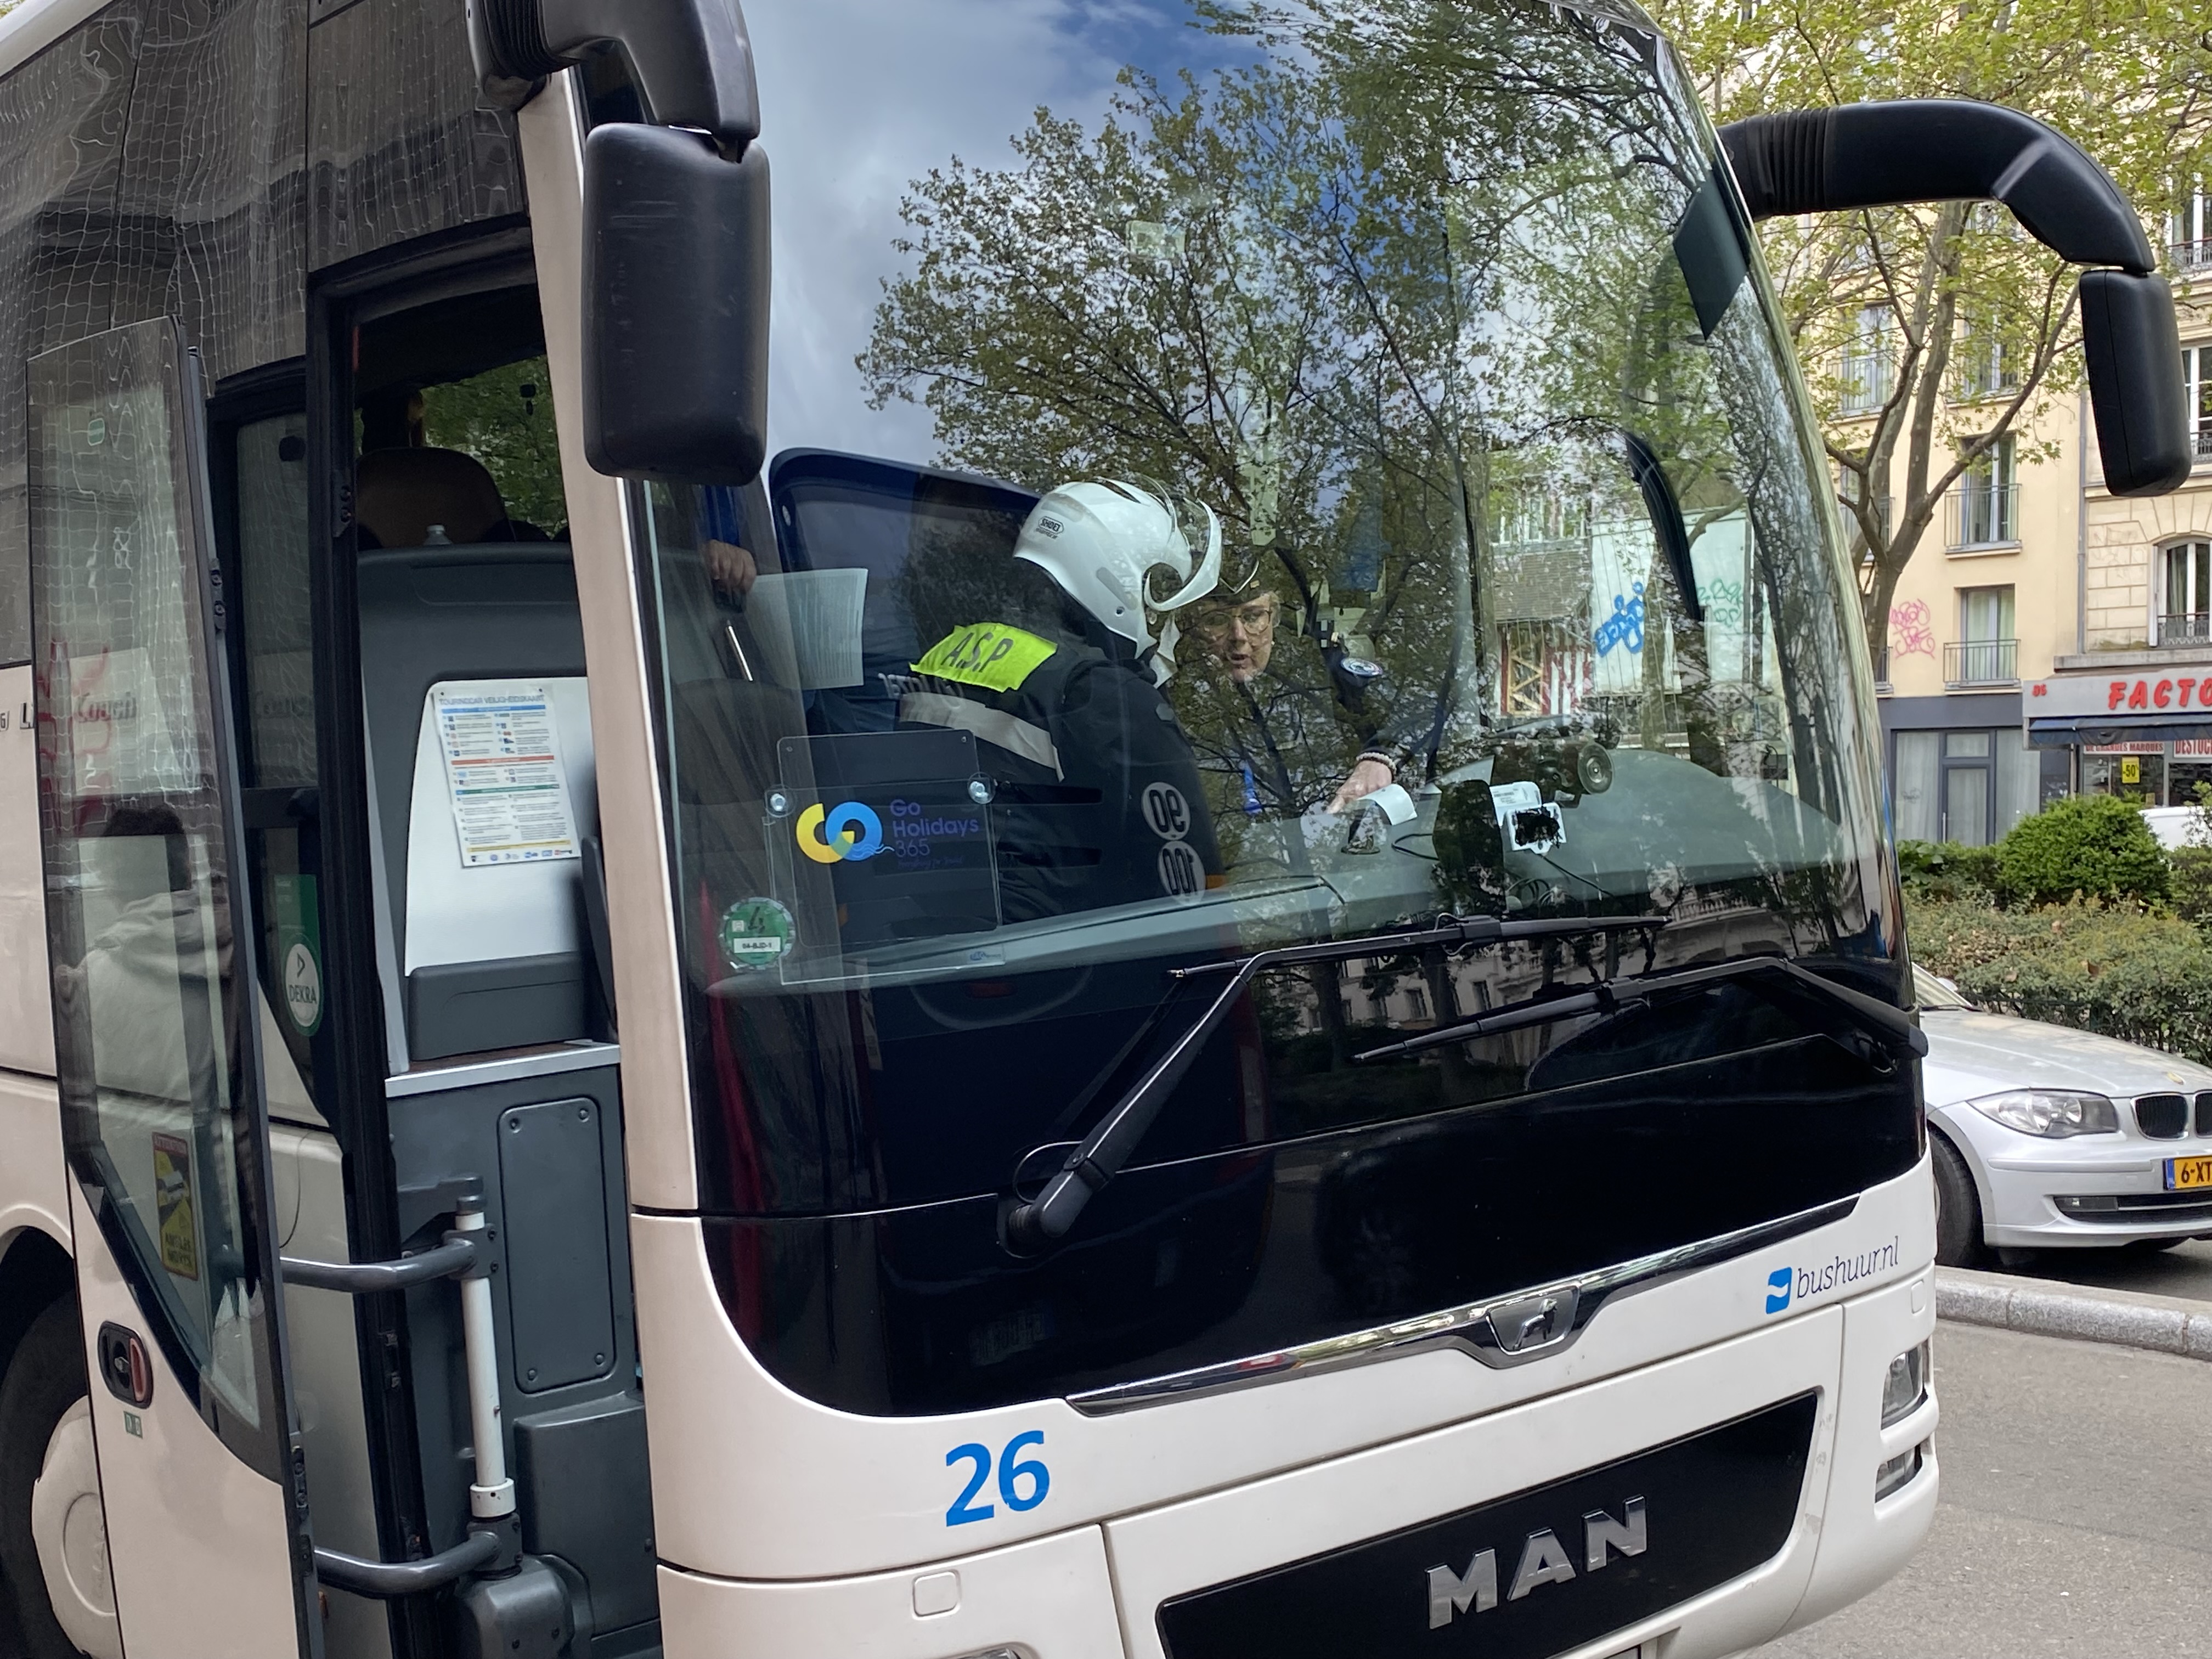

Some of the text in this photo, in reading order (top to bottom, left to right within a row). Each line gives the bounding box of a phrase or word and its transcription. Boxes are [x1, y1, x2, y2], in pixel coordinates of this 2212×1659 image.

[2130, 743, 2164, 752] MARQUES
[890, 799, 921, 816] Go
[893, 817, 979, 838] Holidays
[895, 838, 930, 857] 365
[289, 984, 317, 1005] DEKRA
[1797, 1235, 1899, 1300] bushuur.nl
[946, 1430, 1050, 1527] 26
[1425, 1494, 1647, 1630] MAN
